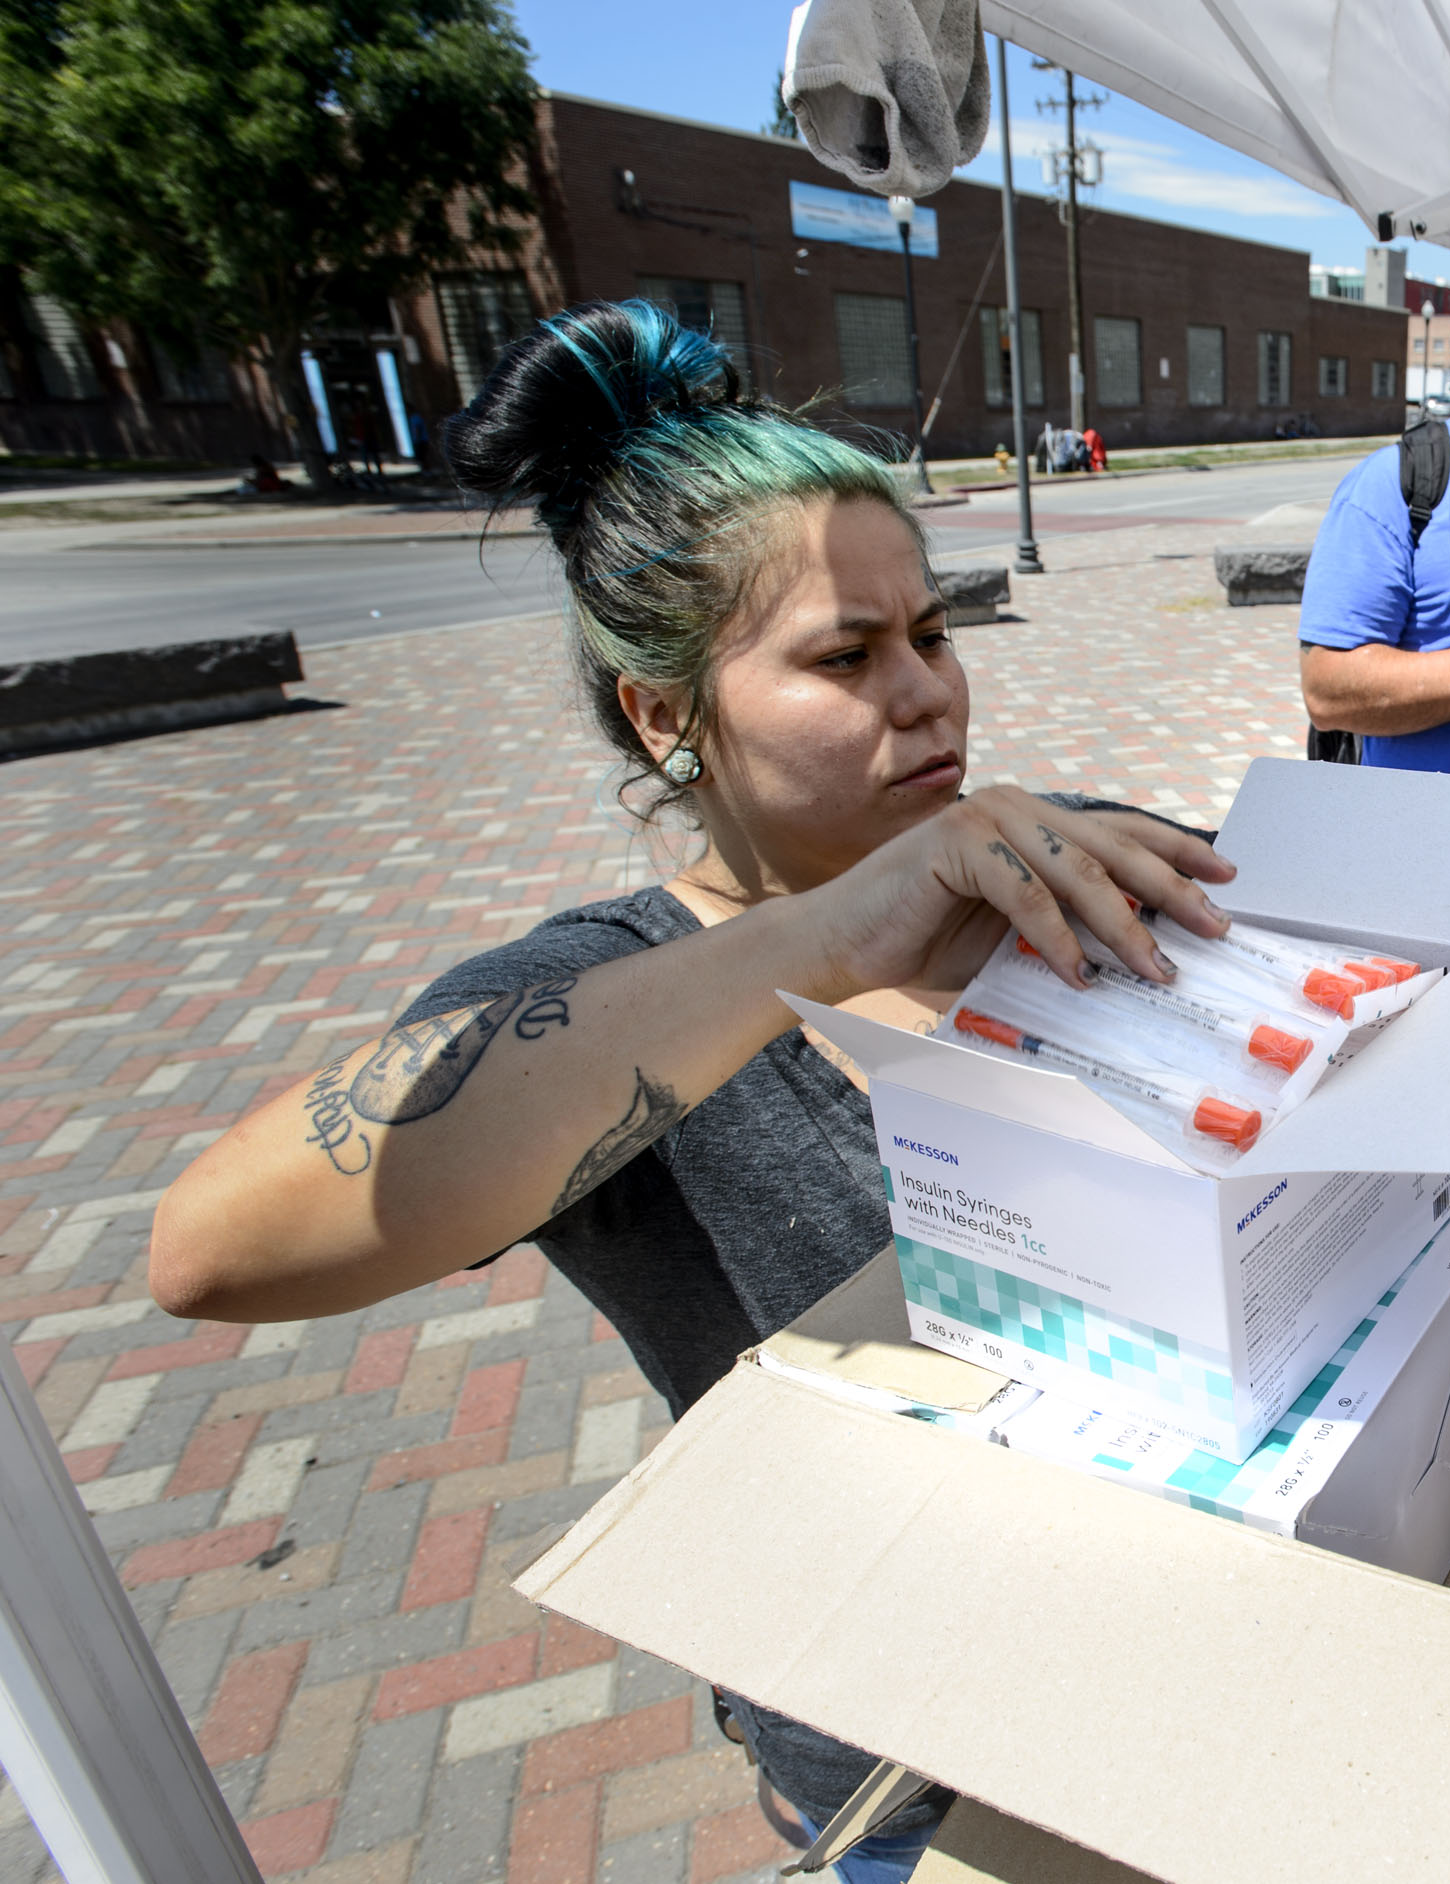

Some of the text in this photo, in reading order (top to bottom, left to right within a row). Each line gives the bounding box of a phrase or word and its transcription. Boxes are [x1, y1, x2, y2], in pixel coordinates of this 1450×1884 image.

[893, 1135, 960, 1166] McKESSON
[900, 1170, 1033, 1230] Insulin Syringes
[904, 1196, 1048, 1256] with Needles 1cc
[907, 1215, 946, 1237] INDIVIDUALLY
[983, 1241, 1009, 1256] STERILE
[1076, 1275, 1112, 1293] NON-TOXIC
[925, 1320, 947, 1337] 28G
[983, 1343, 1003, 1359] 100
[1275, 1477, 1298, 1497] 28G
[1294, 1469, 1305, 1477] x
[1313, 1422, 1334, 1441] 100
